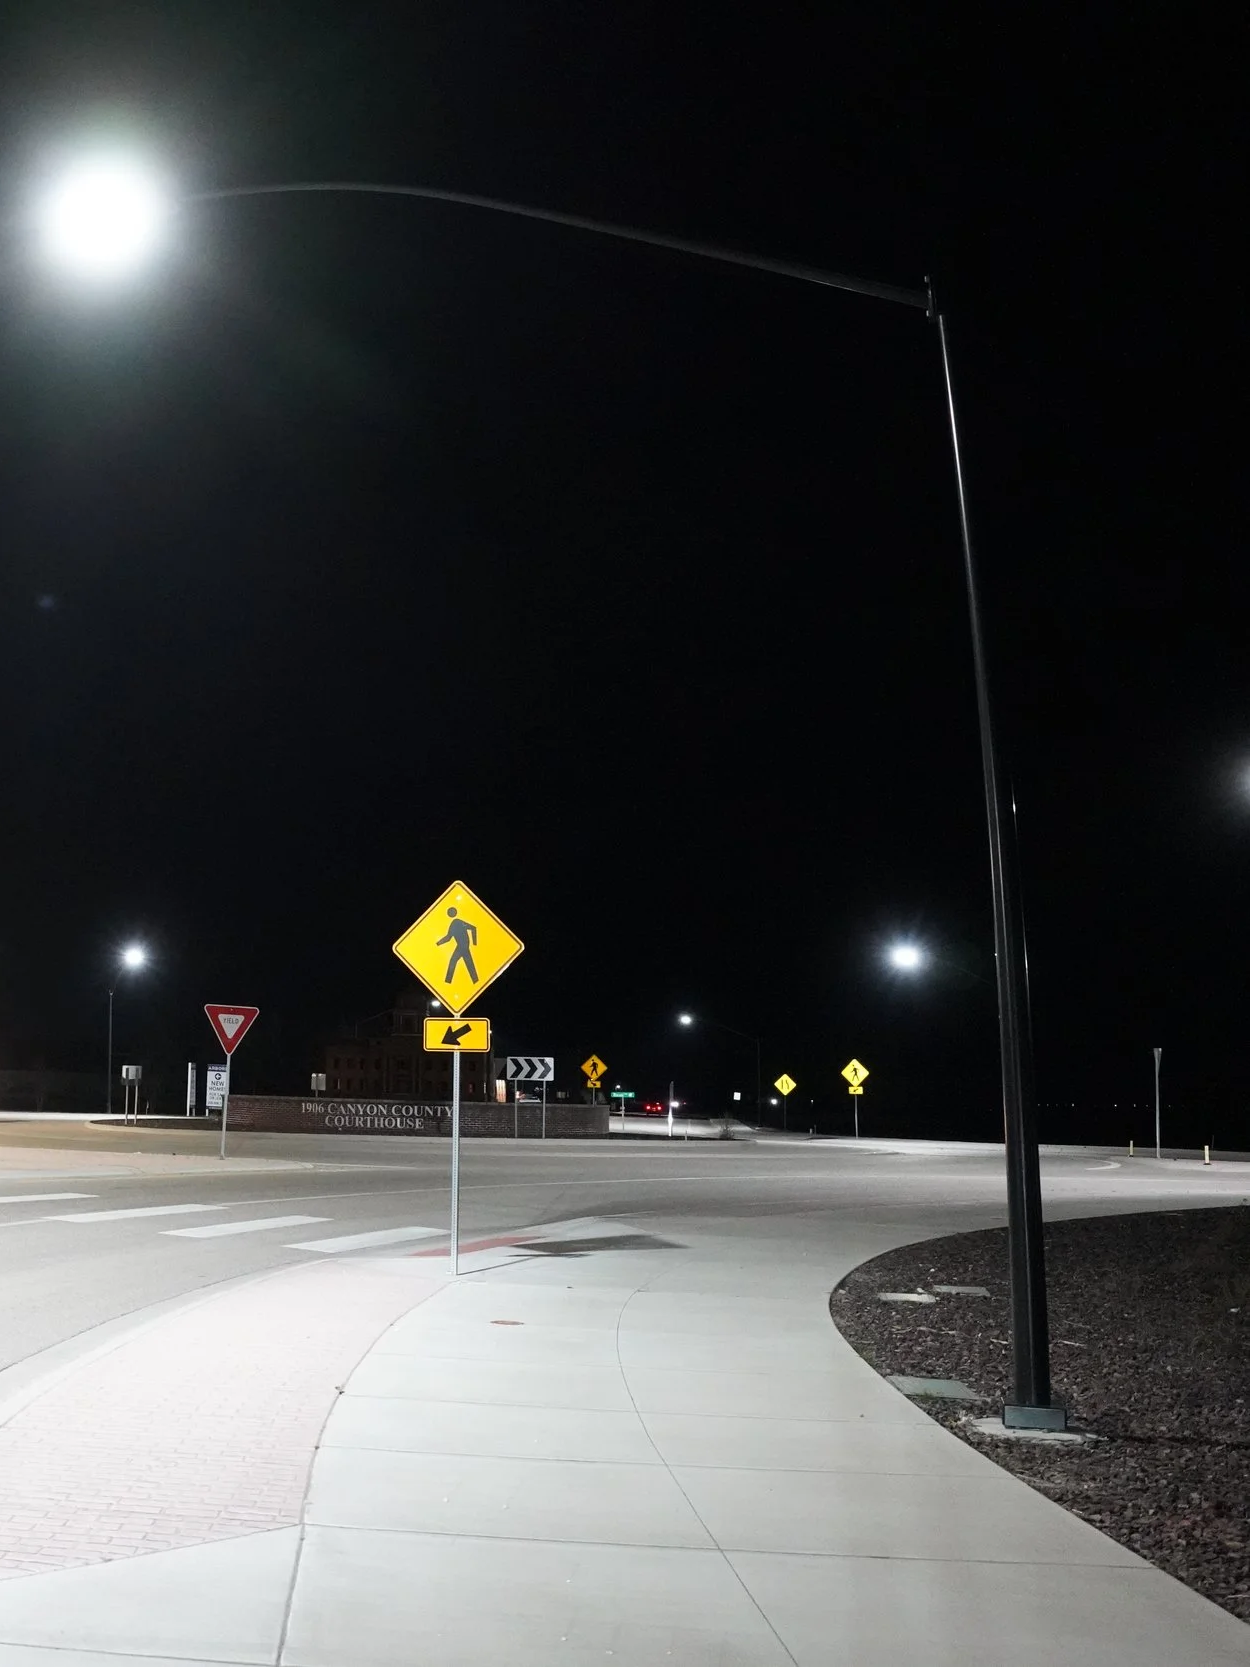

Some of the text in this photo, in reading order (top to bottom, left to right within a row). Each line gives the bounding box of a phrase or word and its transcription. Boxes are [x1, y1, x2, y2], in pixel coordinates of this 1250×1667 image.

[301, 1102, 453, 1117] 1906 CANYON COUNTY
[325, 1116, 424, 1129] COURTHOUSE
